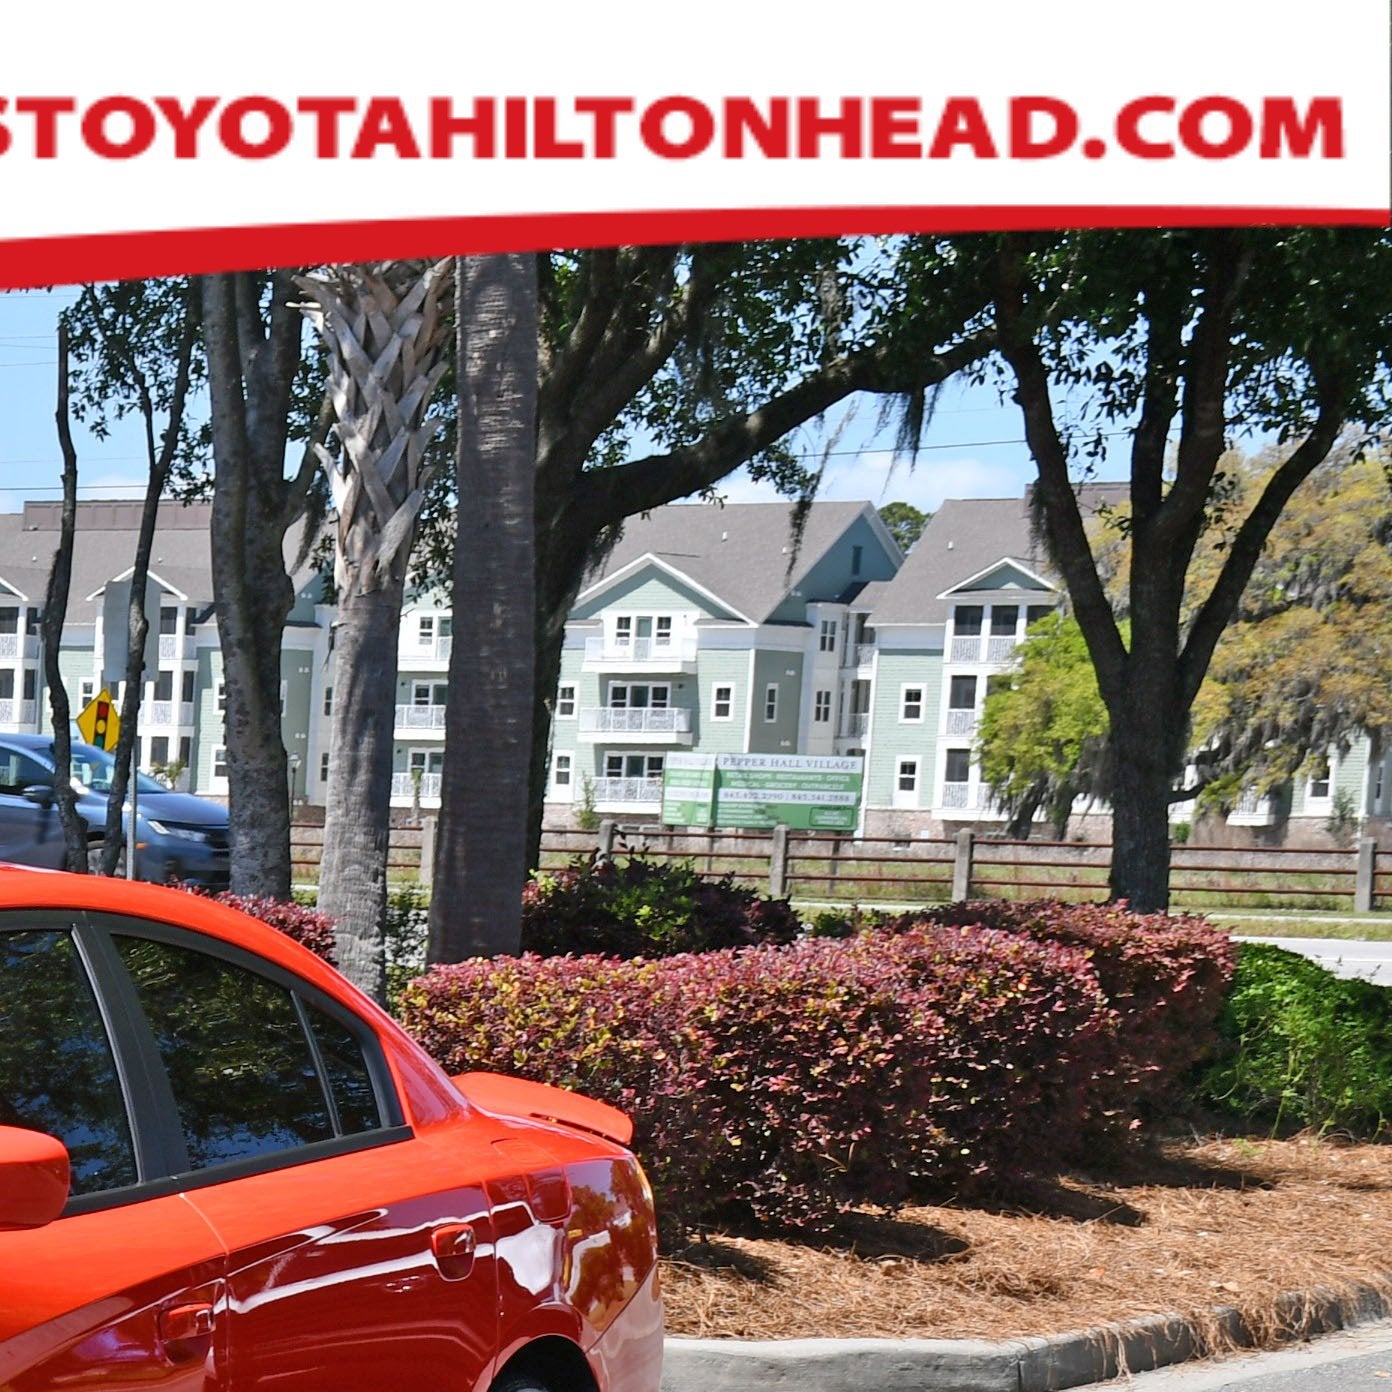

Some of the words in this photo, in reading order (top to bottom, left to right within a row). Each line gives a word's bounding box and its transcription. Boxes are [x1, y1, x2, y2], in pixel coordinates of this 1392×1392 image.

[723, 756, 765, 767] PEPPER
[770, 758, 803, 768] HALL
[806, 759, 857, 770] VILLAGE
